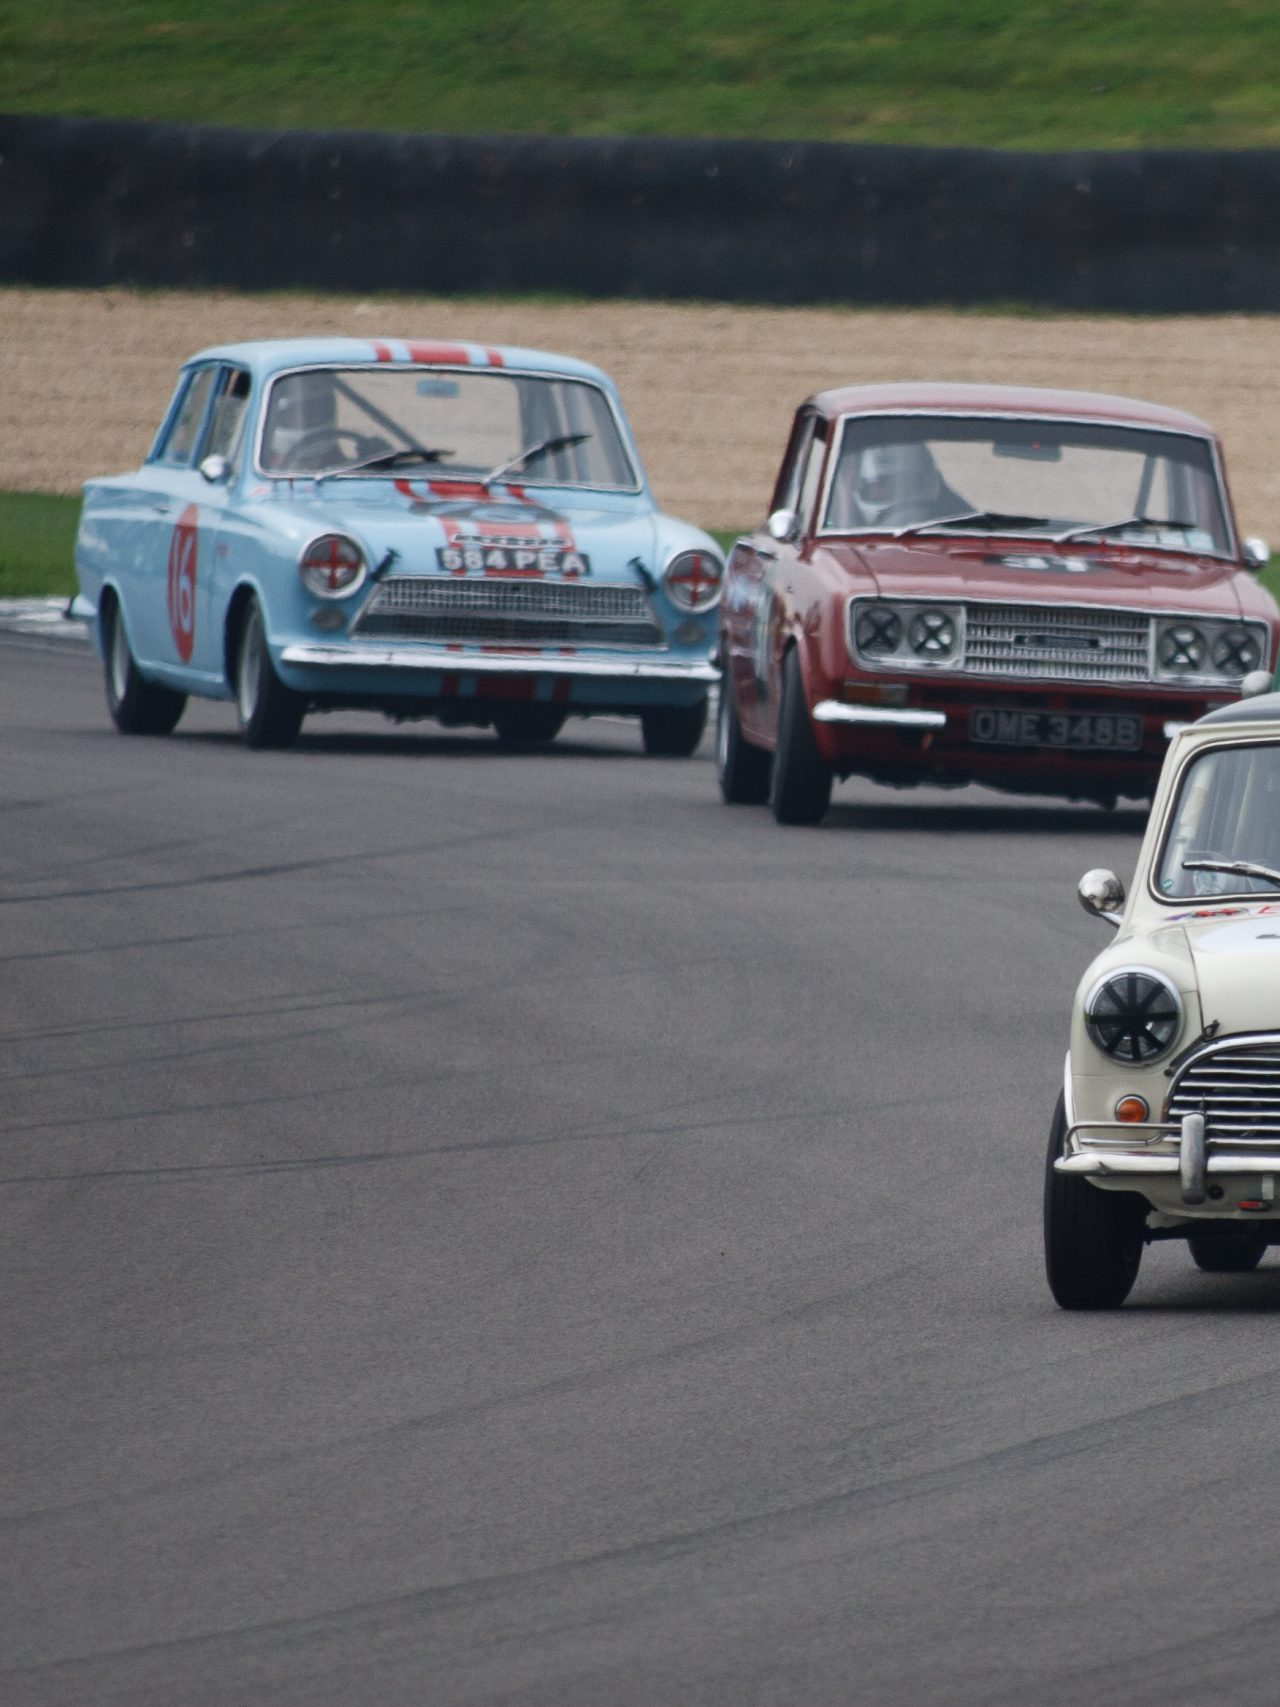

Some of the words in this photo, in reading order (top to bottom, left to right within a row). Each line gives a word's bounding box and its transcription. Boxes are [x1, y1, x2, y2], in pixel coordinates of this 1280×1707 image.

[514, 551, 586, 575] PEA
[173, 529, 193, 634] 16
[975, 711, 1040, 742] OME
